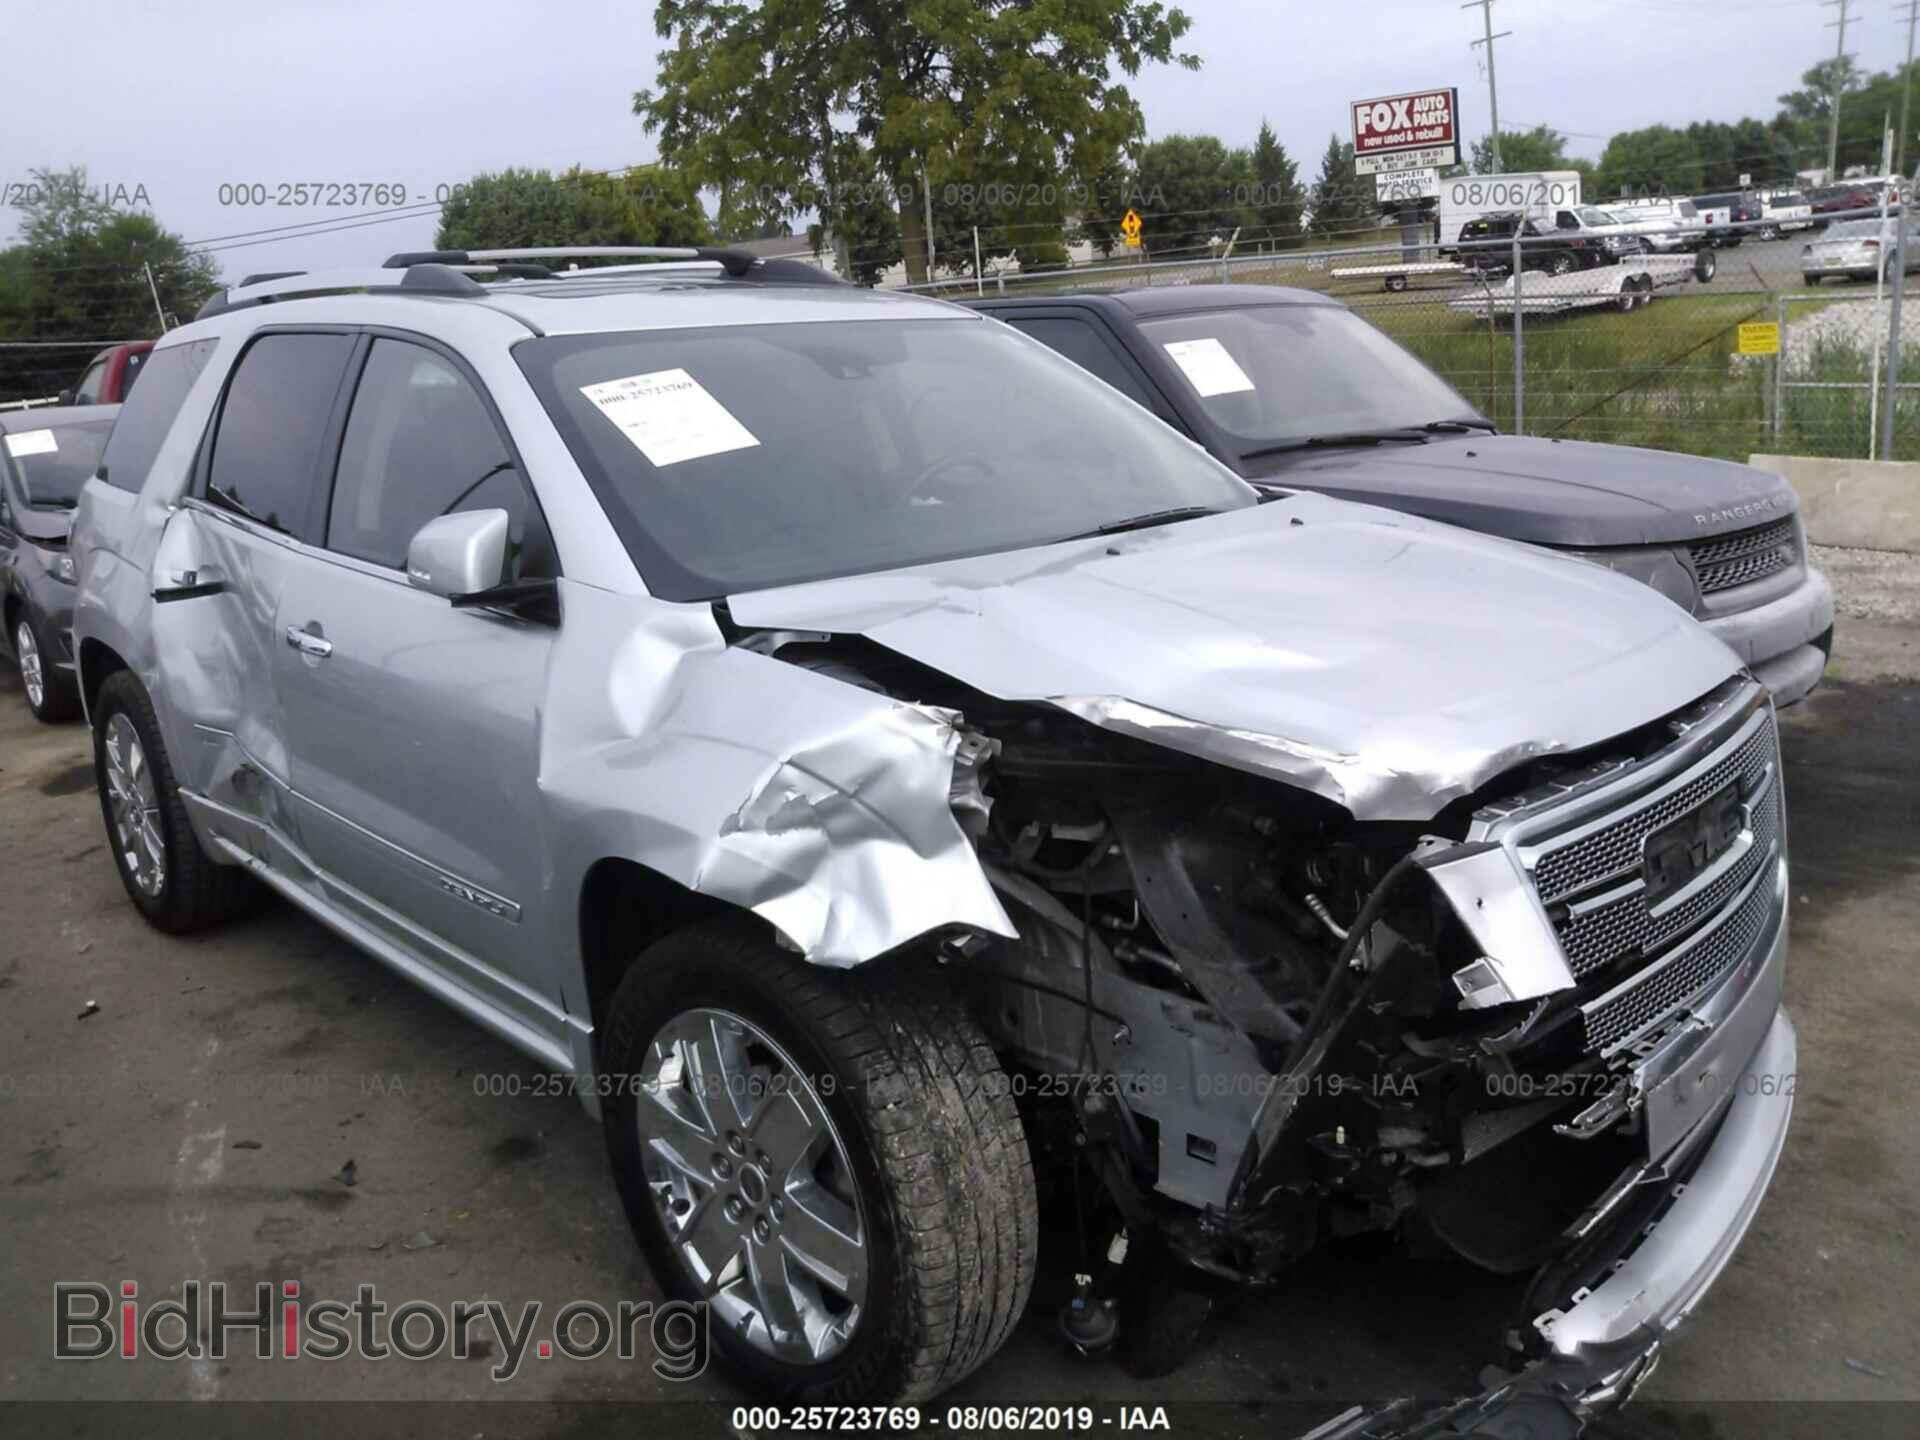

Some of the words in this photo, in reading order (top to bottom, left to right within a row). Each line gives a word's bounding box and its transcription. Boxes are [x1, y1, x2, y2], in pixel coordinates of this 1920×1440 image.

[1413, 95, 1445, 112] AUTO
[1356, 99, 1412, 135] FOX
[1413, 109, 1450, 127] PARTS
[1364, 137, 1382, 147] new
[1384, 132, 1405, 145] used
[1407, 130, 1414, 142] &
[1415, 126, 1444, 140] rebuilt
[1384, 170, 1424, 181] COMPLETE
[1402, 177, 1432, 186] SERVICE
